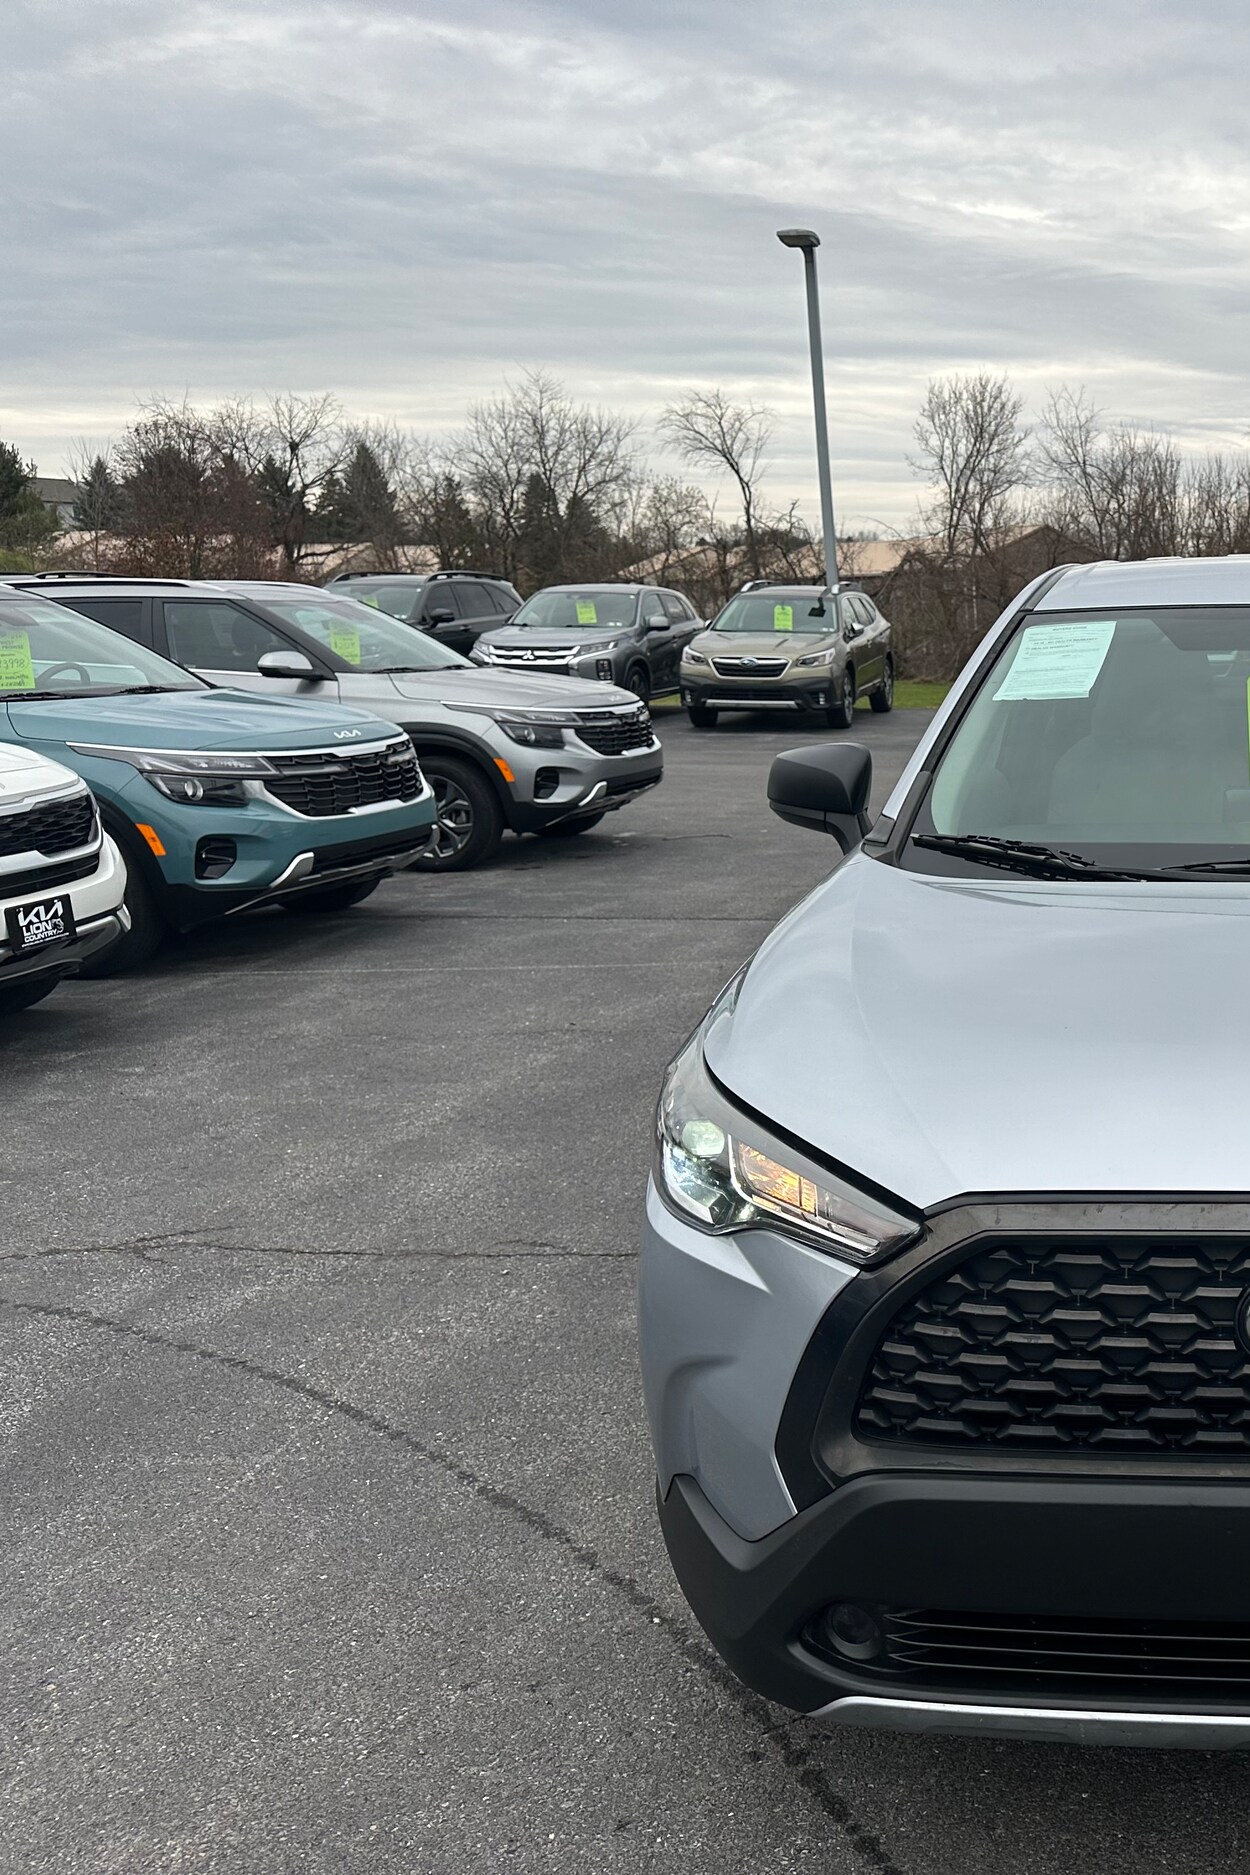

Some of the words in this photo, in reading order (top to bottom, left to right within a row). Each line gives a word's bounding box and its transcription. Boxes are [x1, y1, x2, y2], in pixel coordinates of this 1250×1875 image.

[18, 900, 63, 927] KIA
[22, 920, 52, 937] LION
[24, 929, 57, 943] COUNTRY
